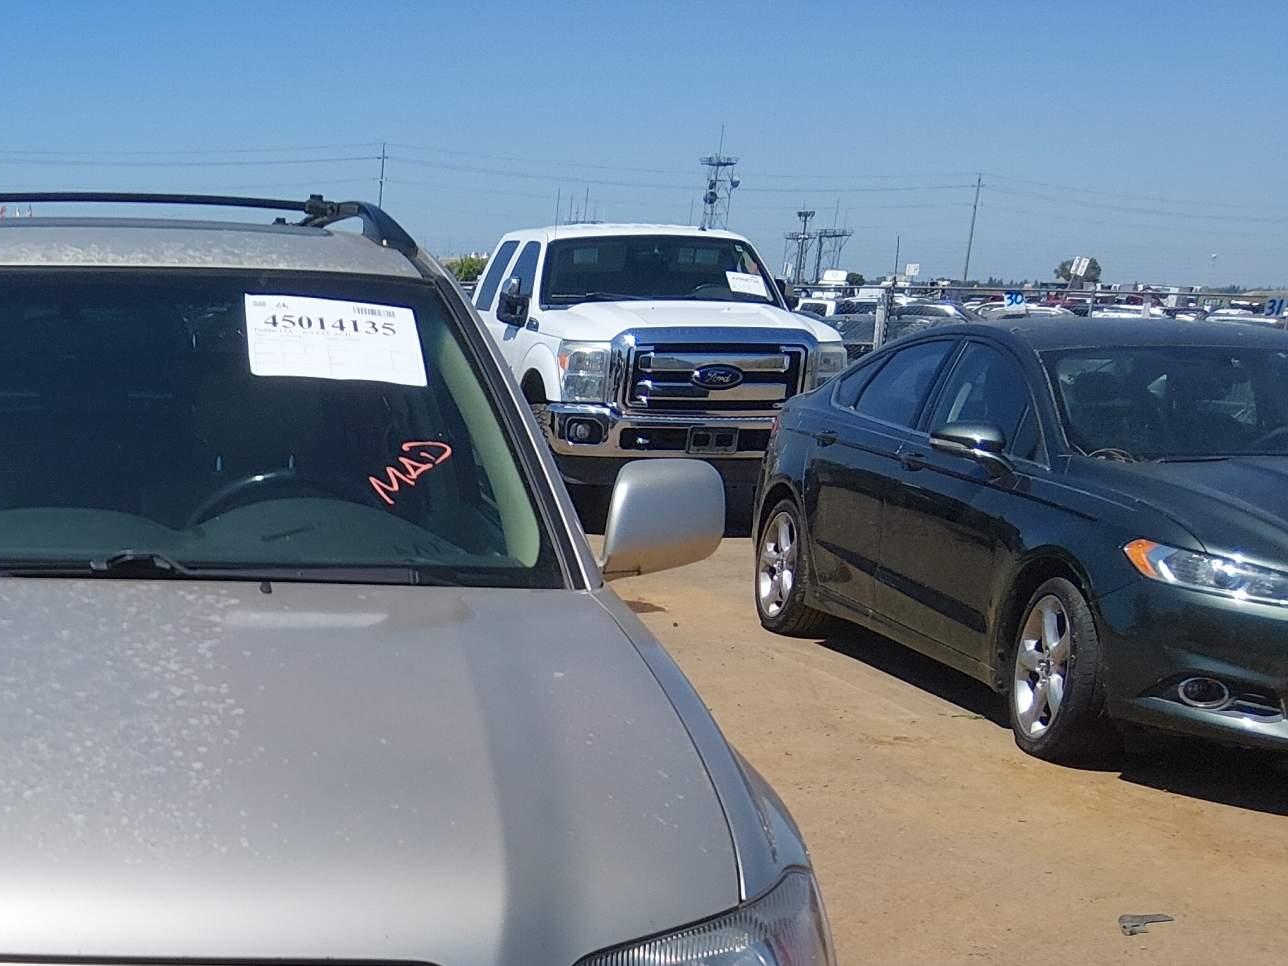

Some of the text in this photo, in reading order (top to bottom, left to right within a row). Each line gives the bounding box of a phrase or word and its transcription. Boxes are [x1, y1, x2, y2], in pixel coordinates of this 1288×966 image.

[1004, 291, 1024, 306] 30
[1265, 299, 1284, 316] 31
[263, 314, 397, 337] 45014135
